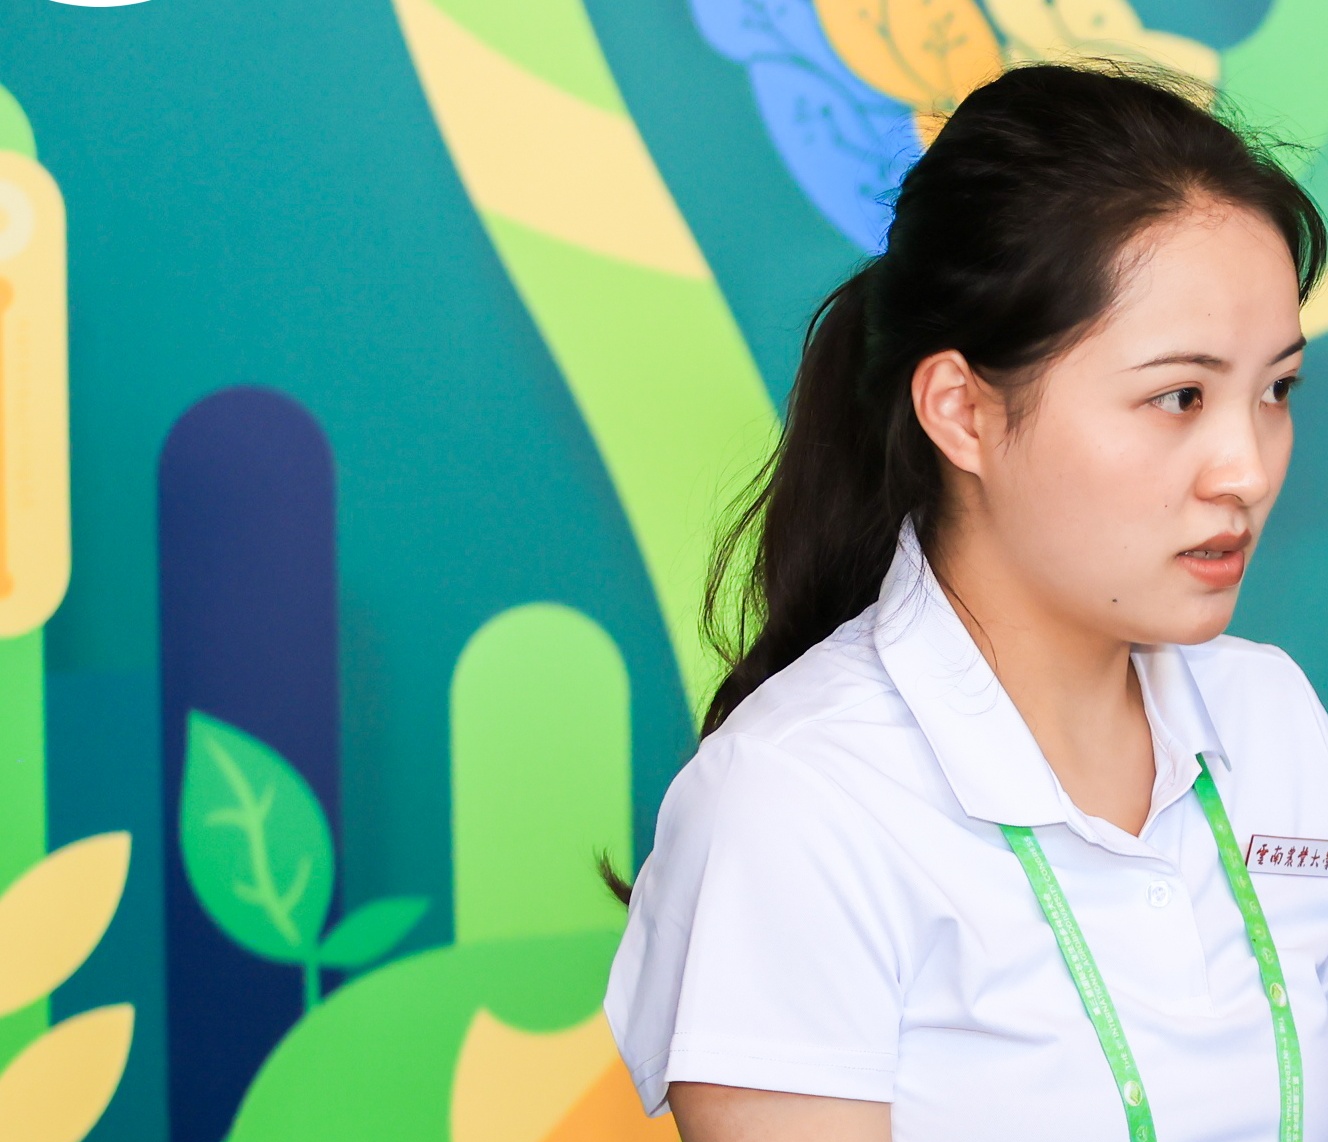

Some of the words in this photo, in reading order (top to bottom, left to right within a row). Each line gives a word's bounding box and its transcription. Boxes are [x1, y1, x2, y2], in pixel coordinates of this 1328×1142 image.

[1023, 835, 1051, 883] CONGRESS
[1047, 884, 1091, 968] AGROBIODIVERSITY
[1085, 967, 1120, 1039] INTERNATIONAL
[1119, 1051, 1131, 1070] THE
[1278, 1017, 1286, 1034] THE
[1283, 1049, 1292, 1122] INTERNATIONAL
